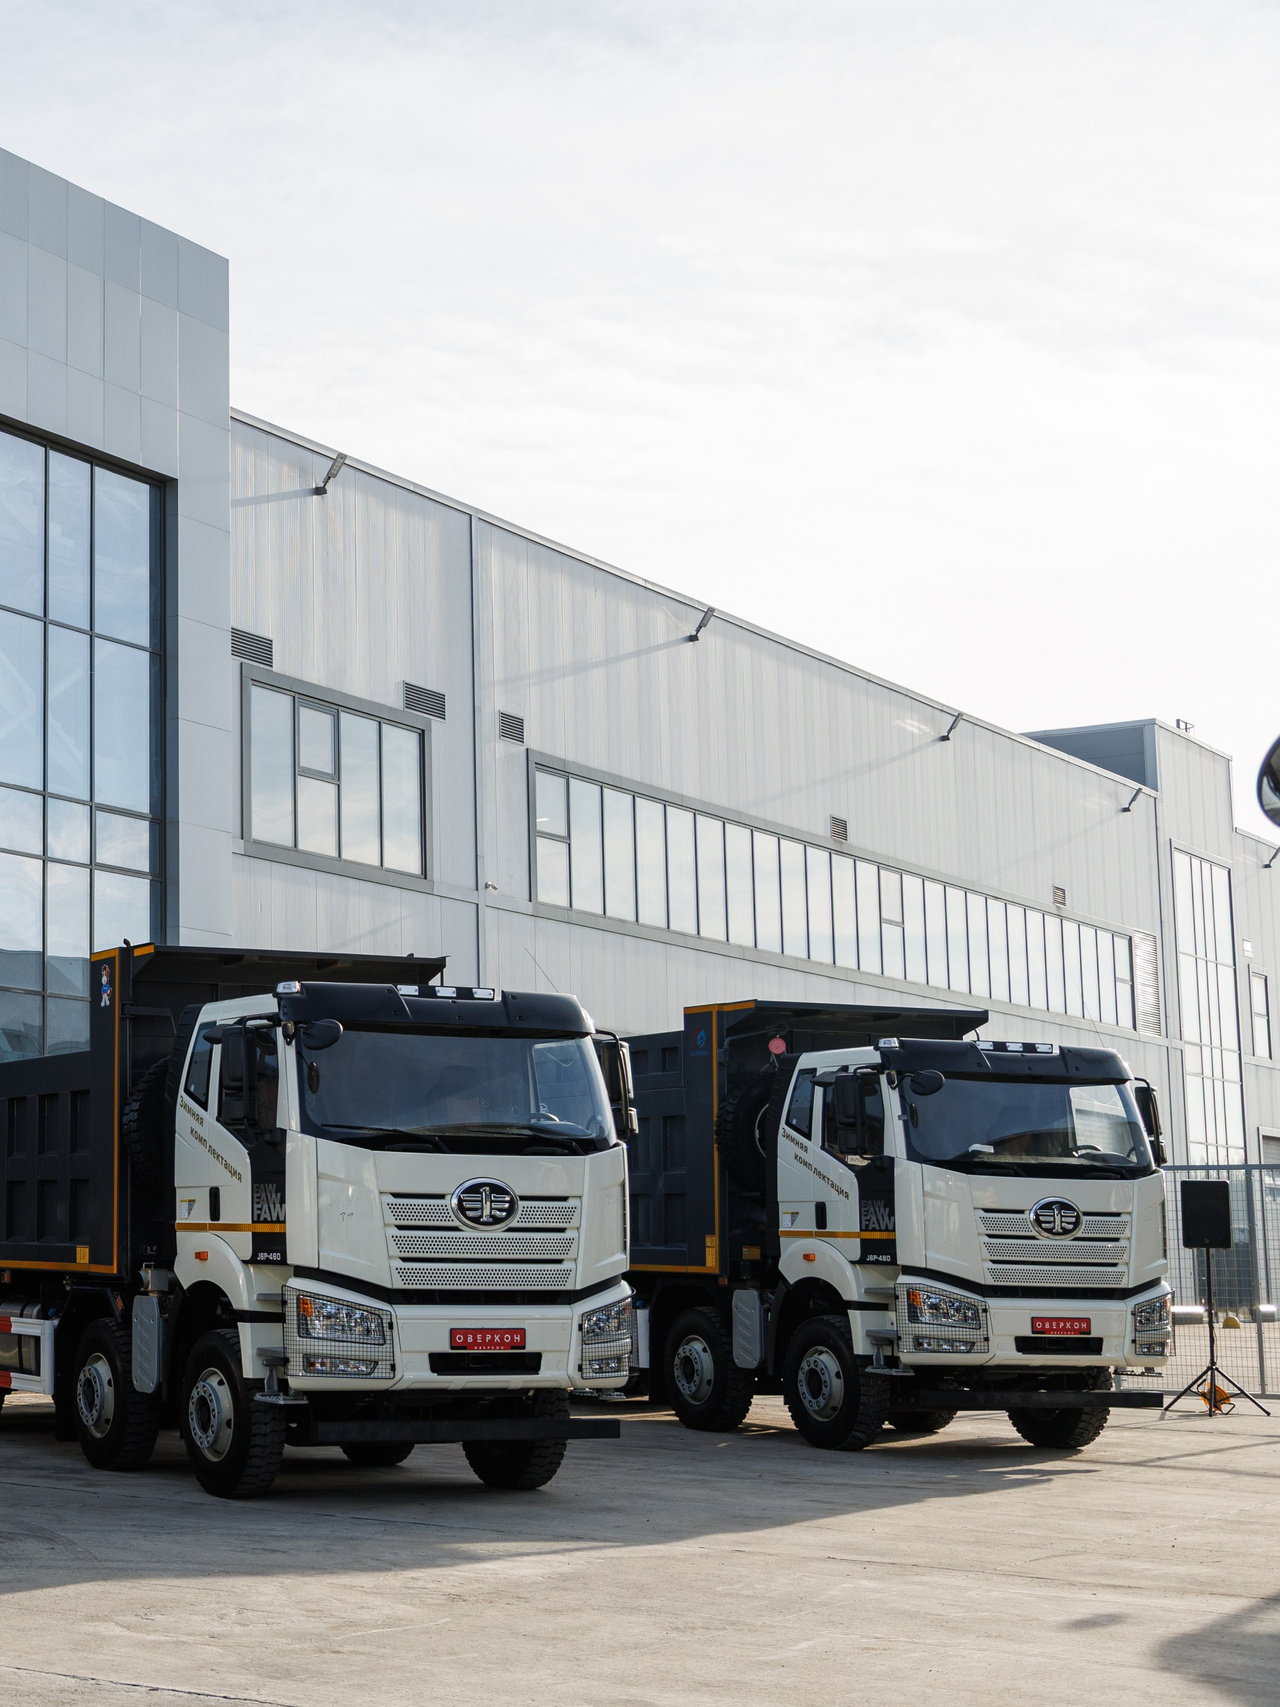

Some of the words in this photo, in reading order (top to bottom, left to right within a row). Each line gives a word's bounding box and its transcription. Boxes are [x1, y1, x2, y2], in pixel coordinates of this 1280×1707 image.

[180, 1096, 204, 1127] Зимняя
[782, 1128, 808, 1154] Зимняя
[253, 1204, 286, 1221] FAW
[861, 1216, 894, 1230] FAW
[1036, 1321, 1087, 1329] ОВЕРКОН
[456, 1334, 521, 1342] ОВЕРКОН
